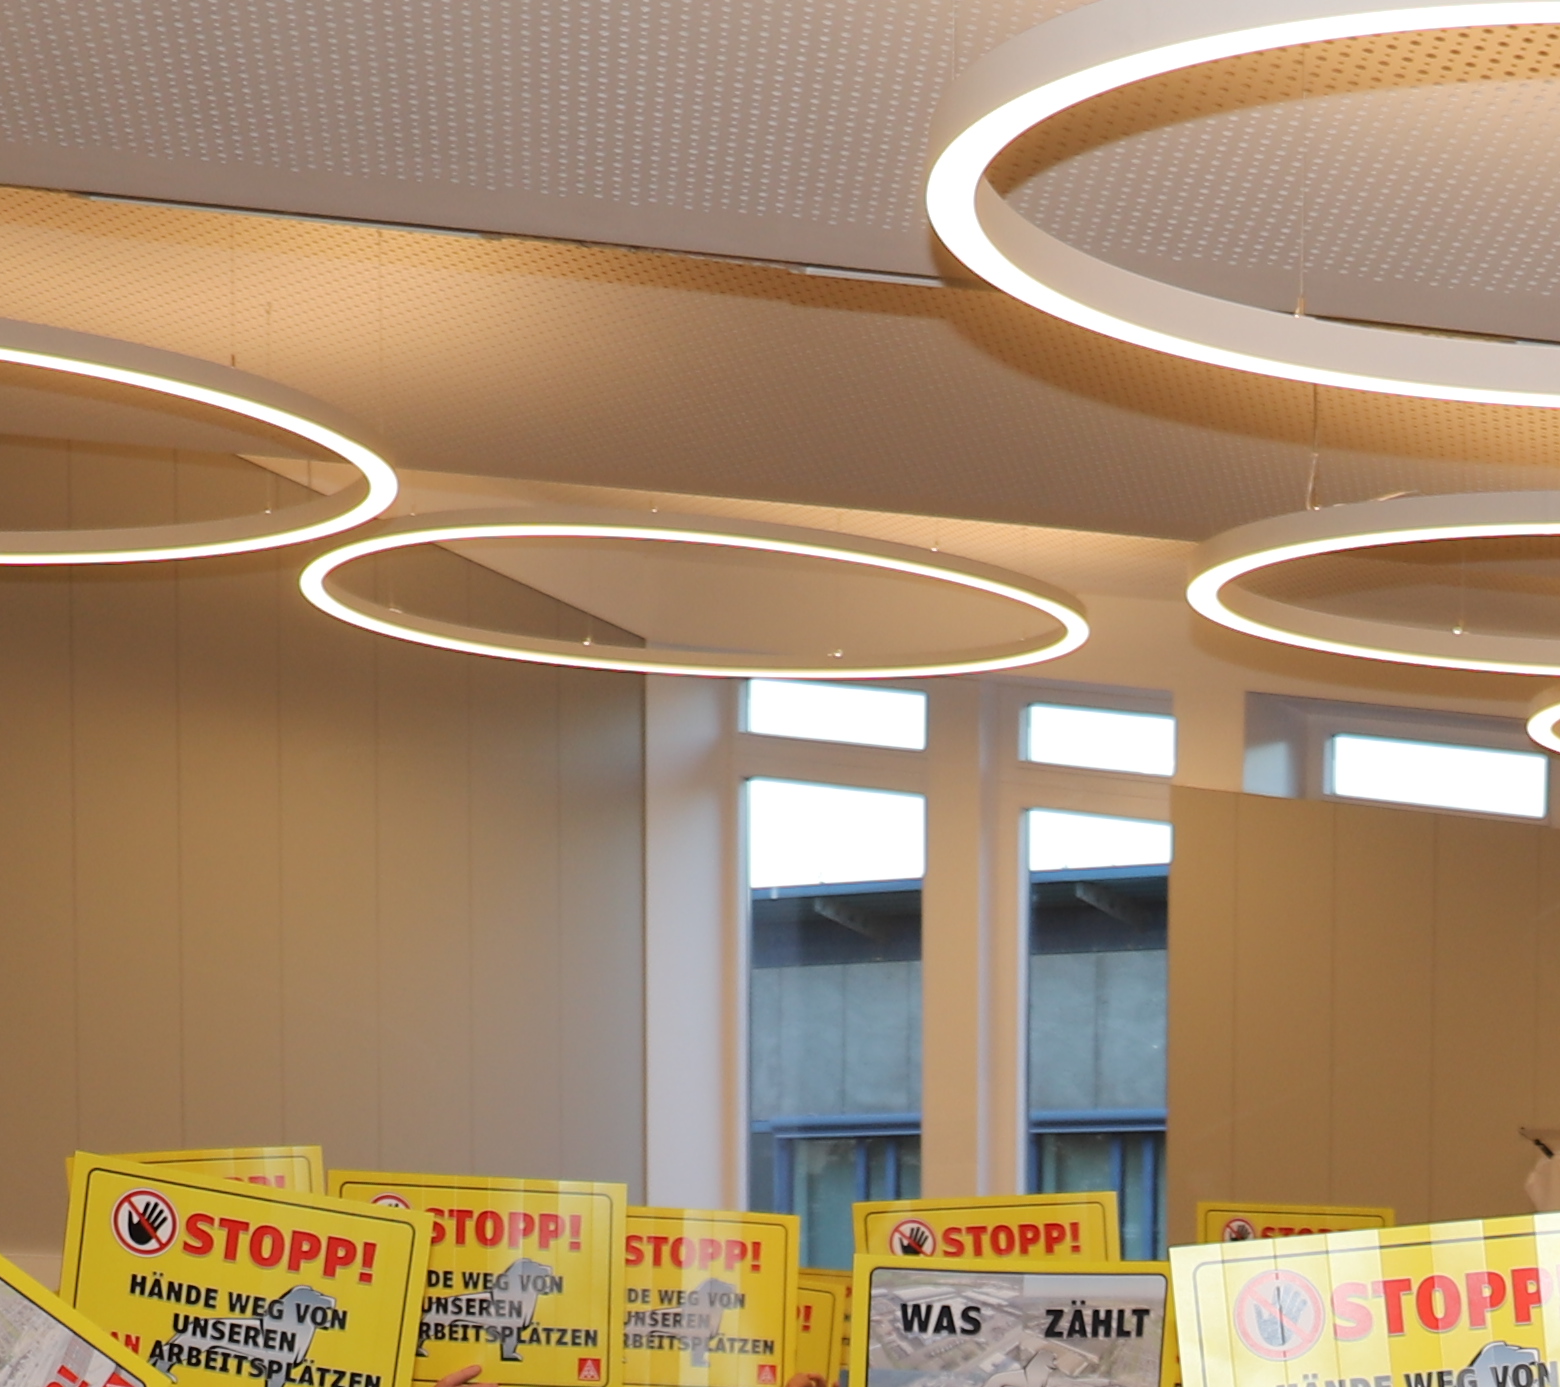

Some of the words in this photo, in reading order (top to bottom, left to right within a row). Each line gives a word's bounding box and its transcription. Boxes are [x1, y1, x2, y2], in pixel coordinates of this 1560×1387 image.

[182, 1212, 378, 1285] STOPP!
[425, 1207, 583, 1252] STOPP!
[942, 1221, 1081, 1257] STOPP!
[624, 1234, 763, 1272] STOPP!
[129, 1271, 219, 1311] HÄNDE
[228, 1291, 285, 1321] WEG
[296, 1302, 348, 1332] VON
[461, 1271, 510, 1293] WEG
[520, 1273, 564, 1296] VON
[659, 1288, 700, 1307] WEG
[707, 1292, 747, 1310] VON
[173, 1313, 297, 1354] UNSEREN
[900, 1303, 983, 1335] WAS
[1044, 1299, 1150, 1339] ZÄHLT
